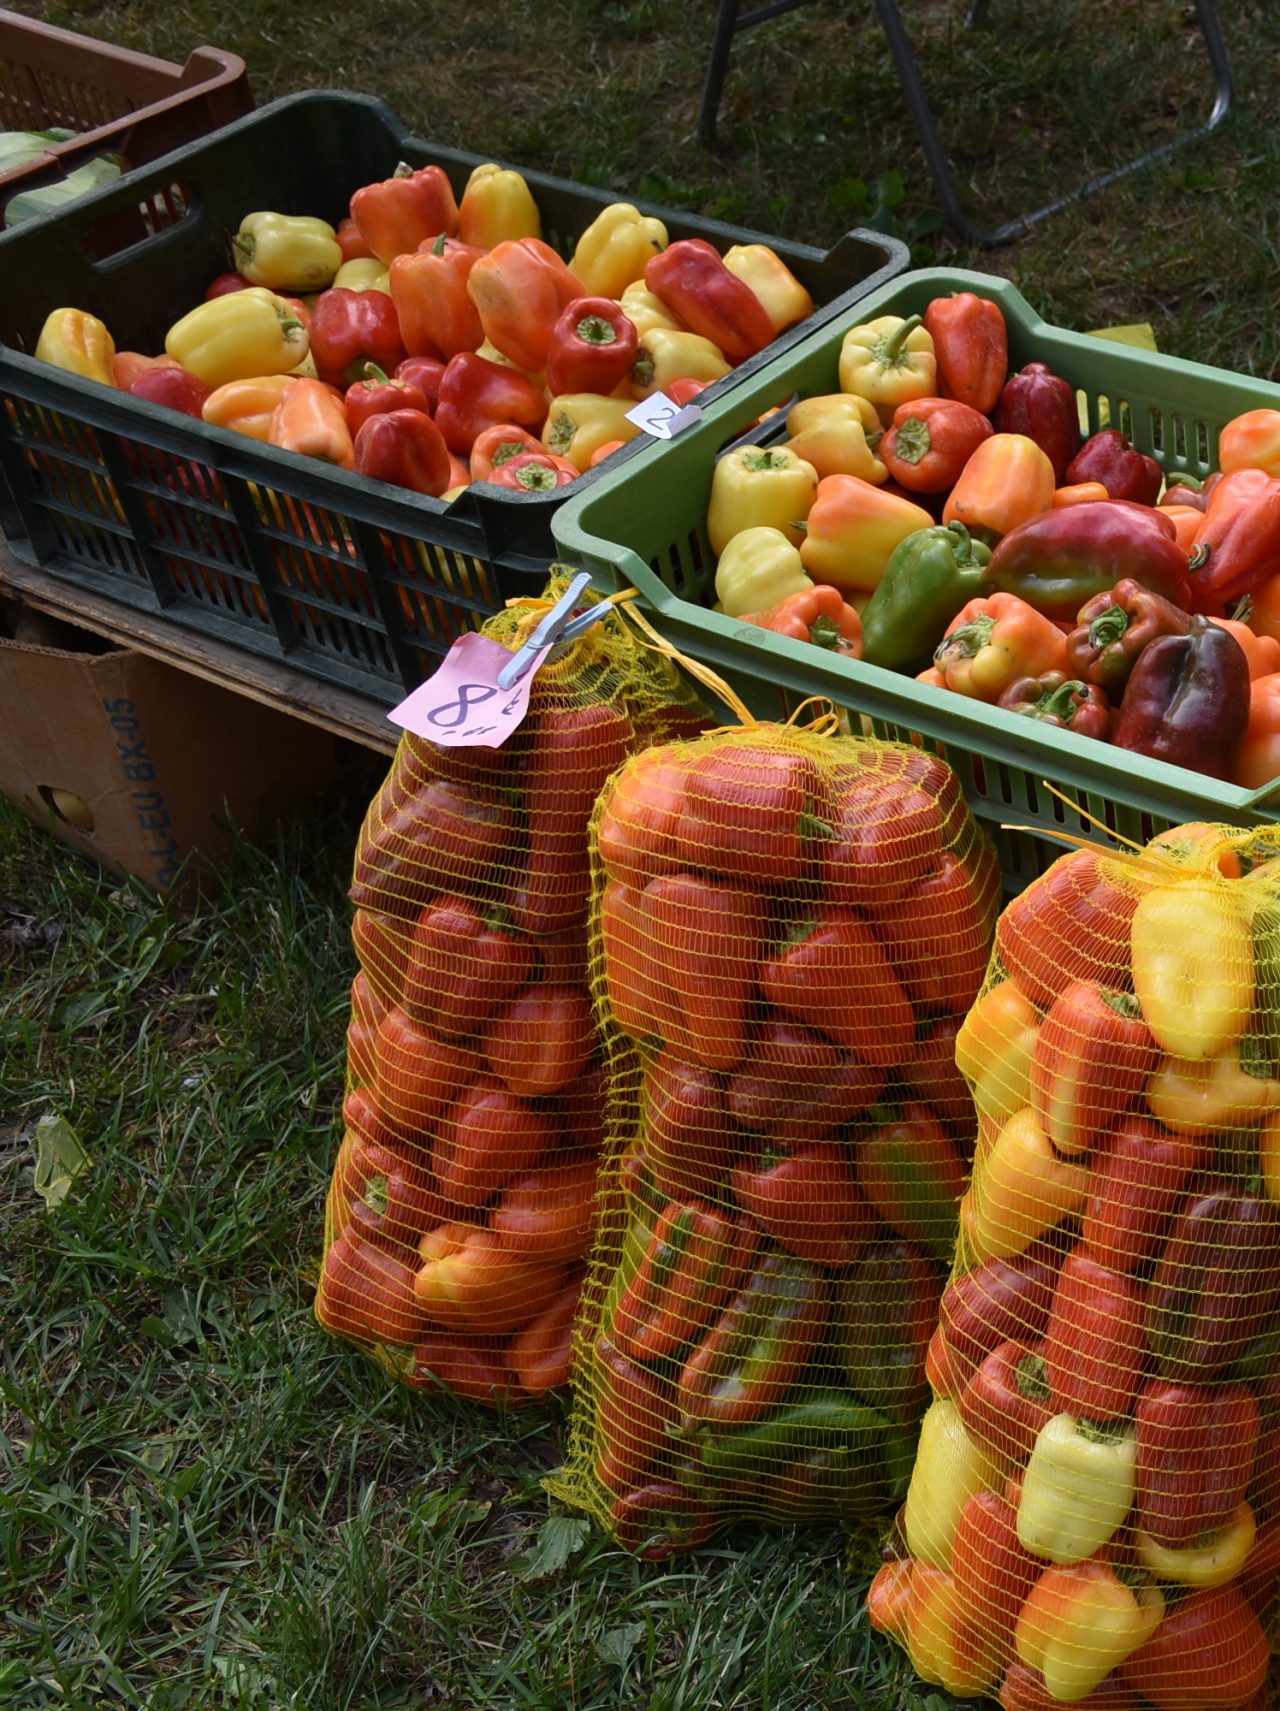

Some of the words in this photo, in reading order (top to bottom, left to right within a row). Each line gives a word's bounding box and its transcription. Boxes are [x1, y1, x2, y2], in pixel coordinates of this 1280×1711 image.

[646, 406, 676, 431] 2
[426, 683, 499, 728] 8
[102, 696, 157, 783] BX-05
